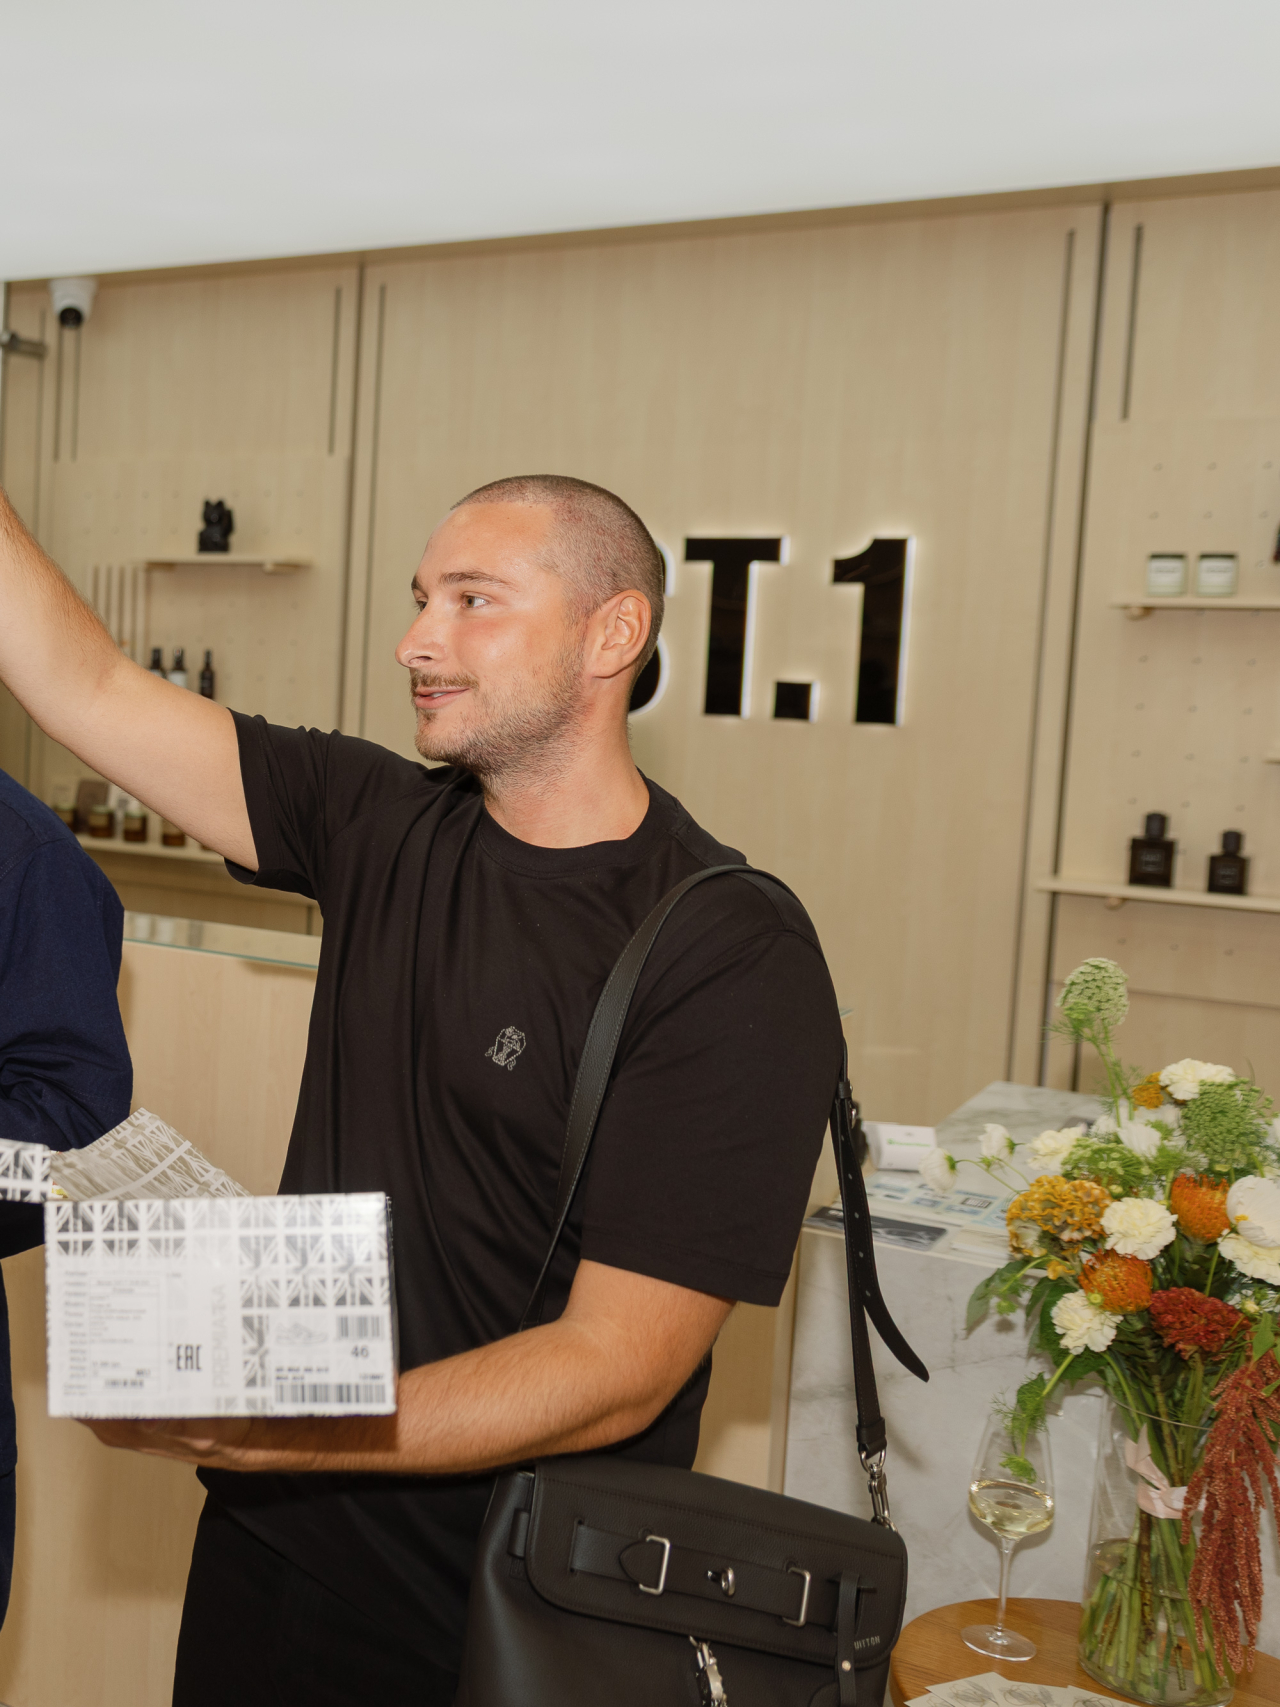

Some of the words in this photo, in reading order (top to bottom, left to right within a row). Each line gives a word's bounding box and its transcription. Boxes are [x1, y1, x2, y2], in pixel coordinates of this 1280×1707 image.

[628, 536, 915, 727] T.1
[176, 1344, 202, 1371] EAC
[351, 1345, 369, 1358] 46
[853, 1635, 881, 1651] UITTON
